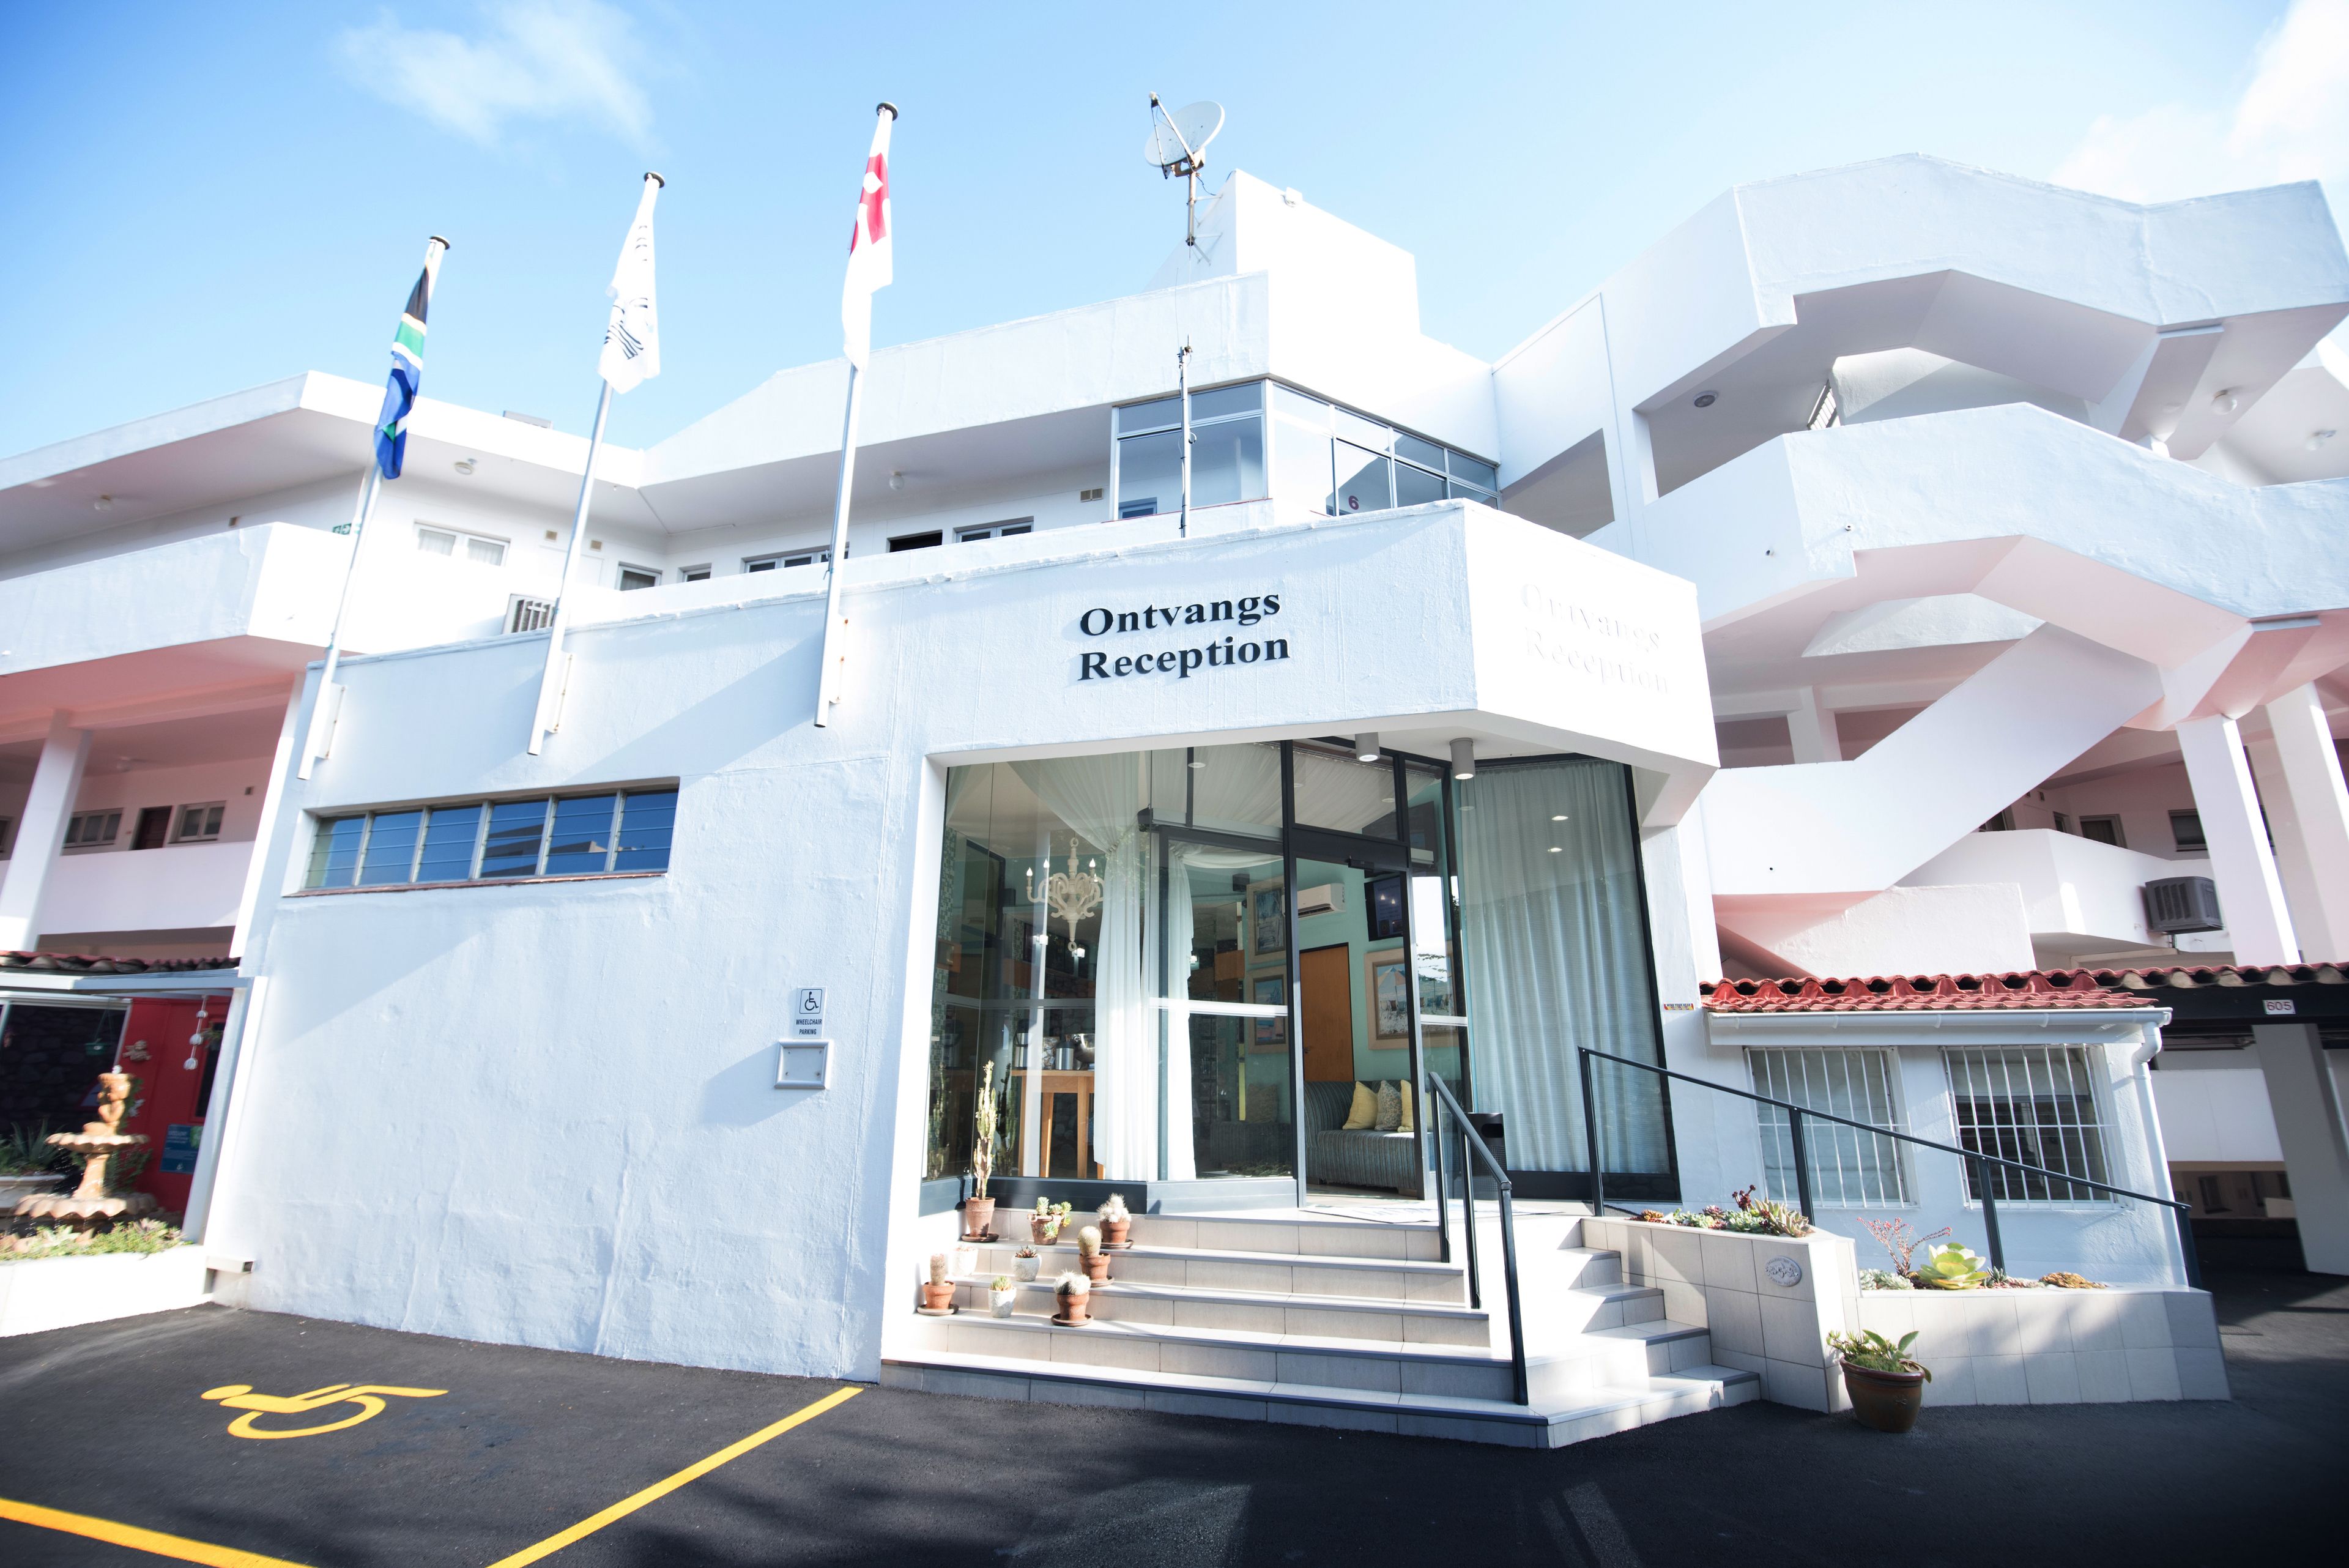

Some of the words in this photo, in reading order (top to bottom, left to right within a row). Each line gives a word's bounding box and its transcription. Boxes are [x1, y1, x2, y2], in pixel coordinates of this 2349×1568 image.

[1348, 495, 1359, 510] 6
[1080, 593, 1280, 636] Ontvangs
[1521, 583, 1660, 653] Ontvangs
[1077, 636, 1289, 681] Reception
[1524, 626, 1669, 694] Reception
[2266, 1001, 2292, 1011] 605
